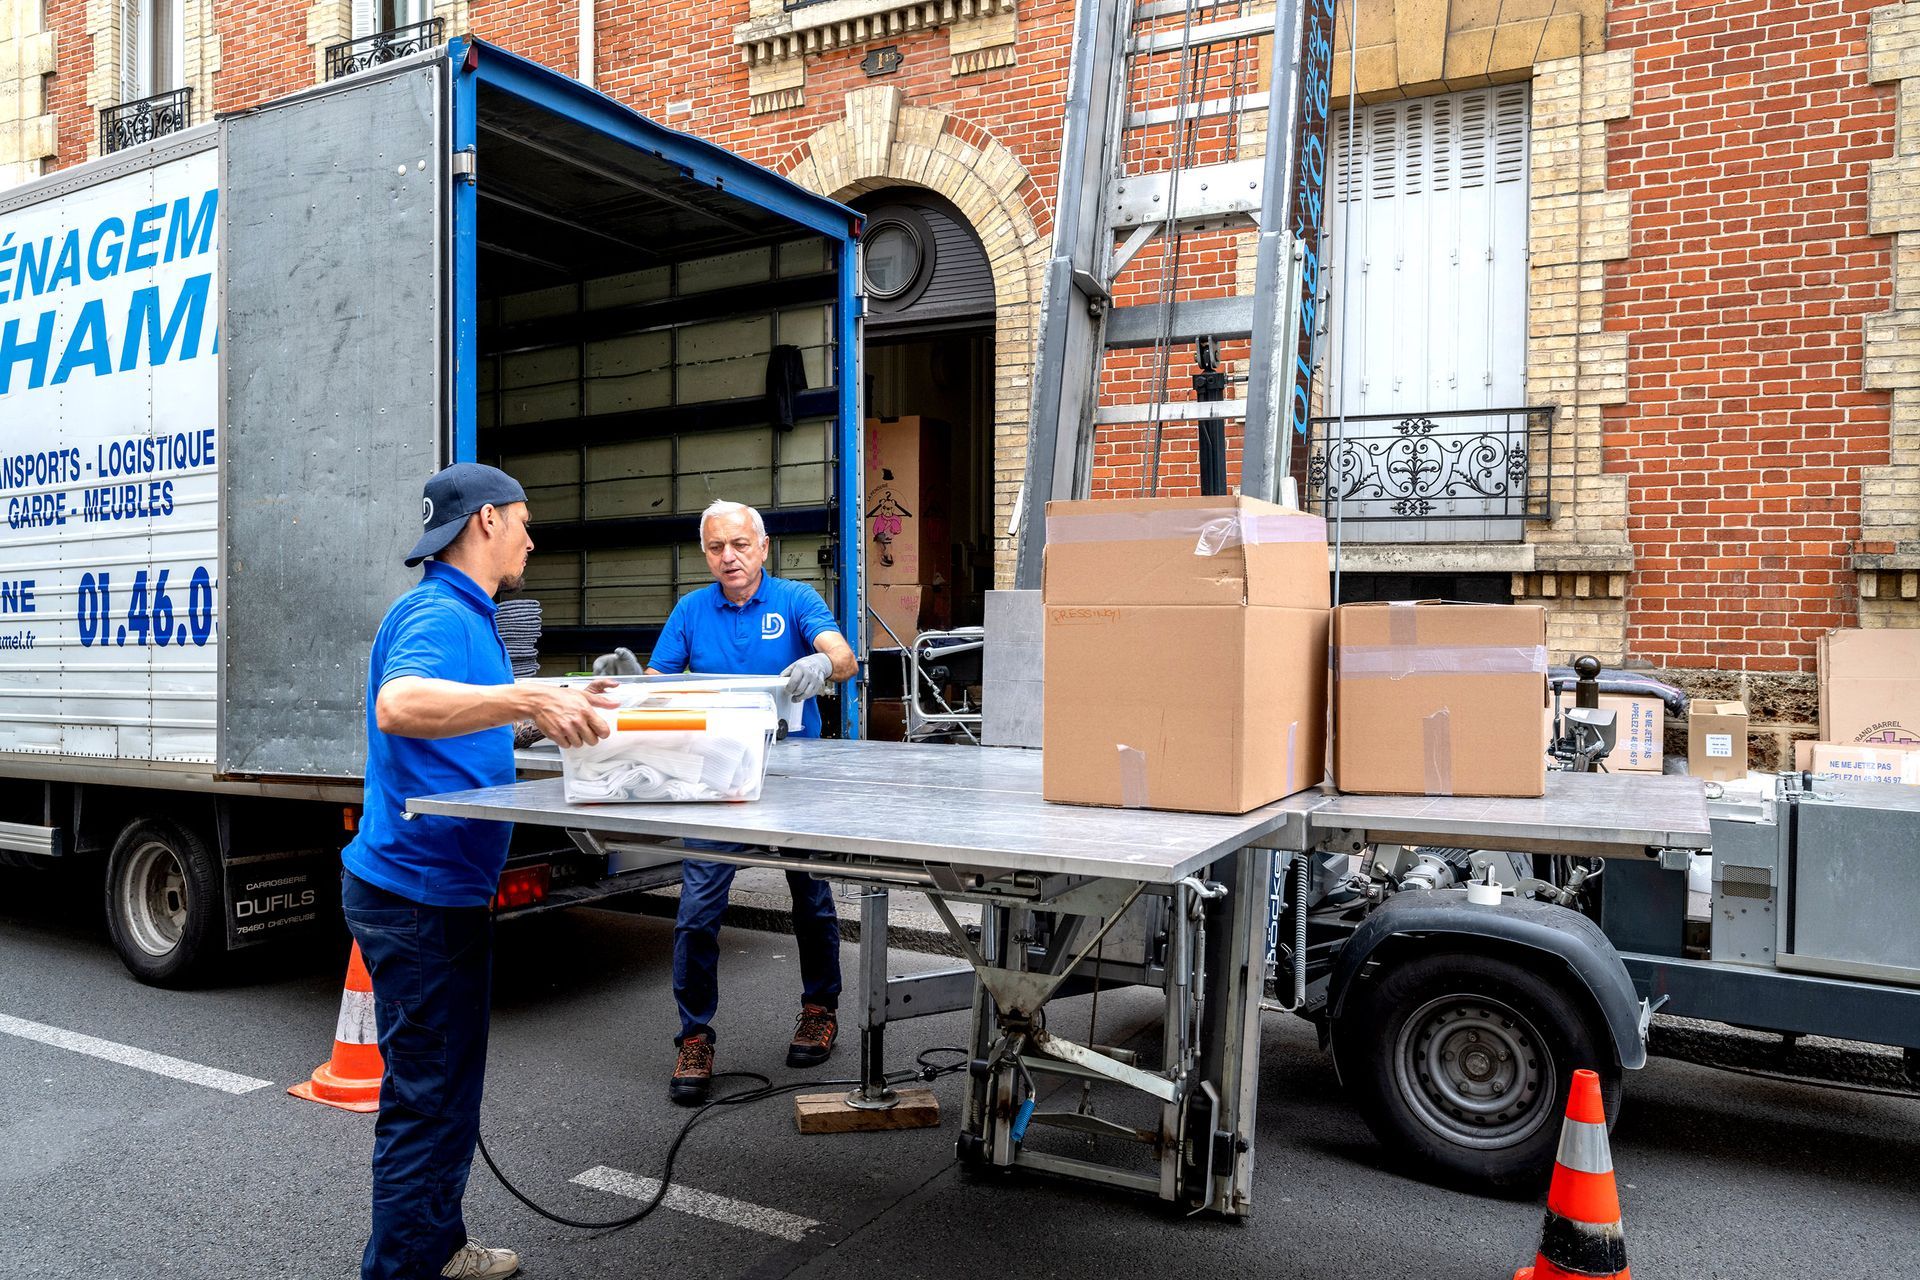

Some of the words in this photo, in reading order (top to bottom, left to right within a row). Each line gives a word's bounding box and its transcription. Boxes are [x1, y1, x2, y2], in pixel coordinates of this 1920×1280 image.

[1314, 25, 1330, 119] 63
[1300, 128, 1310, 213] AVEC
[1307, 134, 1324, 230] 40
[0, 188, 218, 305] ÉNAGEM
[1300, 244, 1317, 337] 48
[0, 273, 218, 395] HAM
[0, 447, 80, 490] NSPORTS
[99, 429, 215, 478] LOGISTIQUE
[8, 493, 66, 530] GARDE
[84, 480, 174, 523] MEUBLES
[2, 580, 35, 613] NE
[78, 566, 218, 647] 01.46.0
[0, 630, 35, 650] mel.fr
[1631, 702, 1639, 728] APPELEZ
[1645, 710, 1653, 718] NE
[1645, 720, 1653, 728] ME
[1853, 727, 1873, 743] RAND
[1872, 720, 1901, 731] BARREL
[1829, 760, 1840, 768] NE
[1841, 761, 1852, 769] ME
[1853, 762, 1876, 770] JETEZ
[1883, 776, 1892, 784] 45
[1892, 776, 1902, 784] 97
[246, 875, 307, 891] CARROSSERIE
[236, 890, 315, 918] DUFILS
[268, 913, 316, 928] CHEVREUSE
